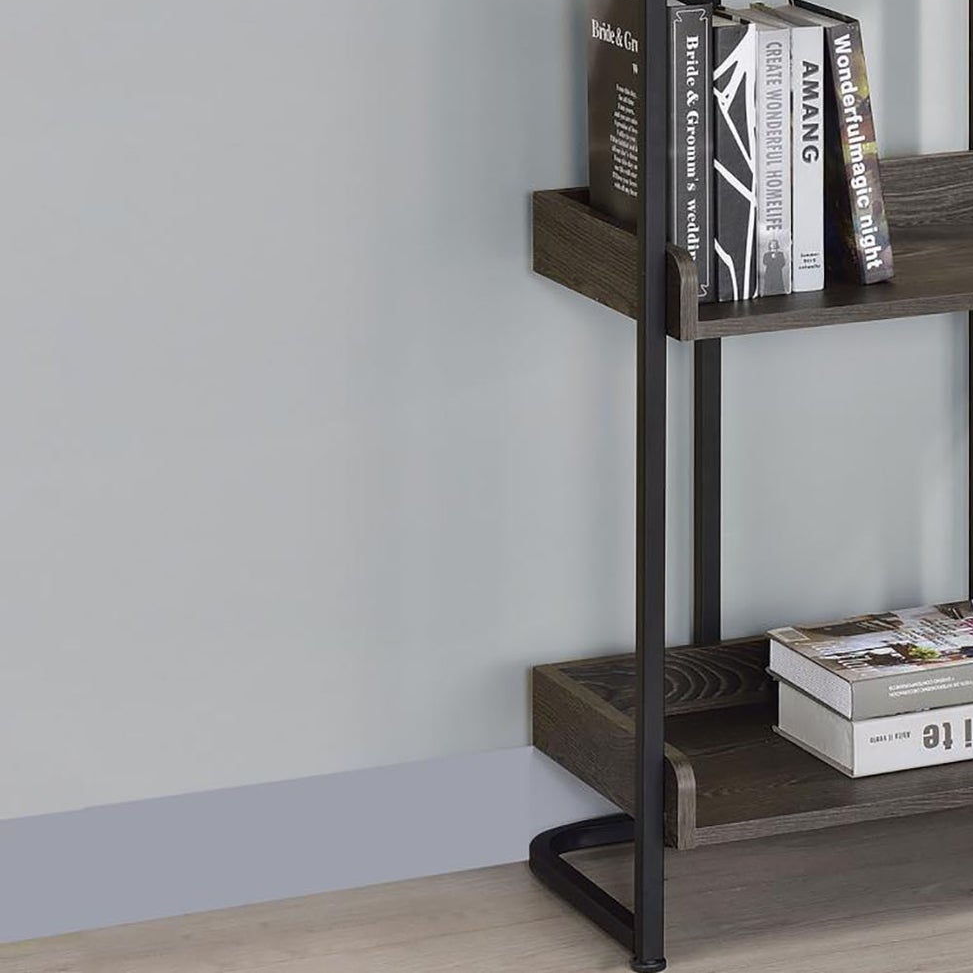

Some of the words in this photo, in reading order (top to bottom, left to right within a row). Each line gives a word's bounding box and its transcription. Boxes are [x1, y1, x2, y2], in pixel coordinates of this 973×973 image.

[591, 18, 615, 44] Bride
[615, 27, 623, 47] &
[686, 35, 699, 87] Bride
[766, 41, 782, 85] CREATE
[686, 90, 699, 107] &
[802, 60, 819, 163] AMANG
[766, 88, 782, 166] WONDERFUL
[766, 170, 782, 231] HOMELIFE
[860, 214, 883, 270] night
[922, 722, 953, 750] te
